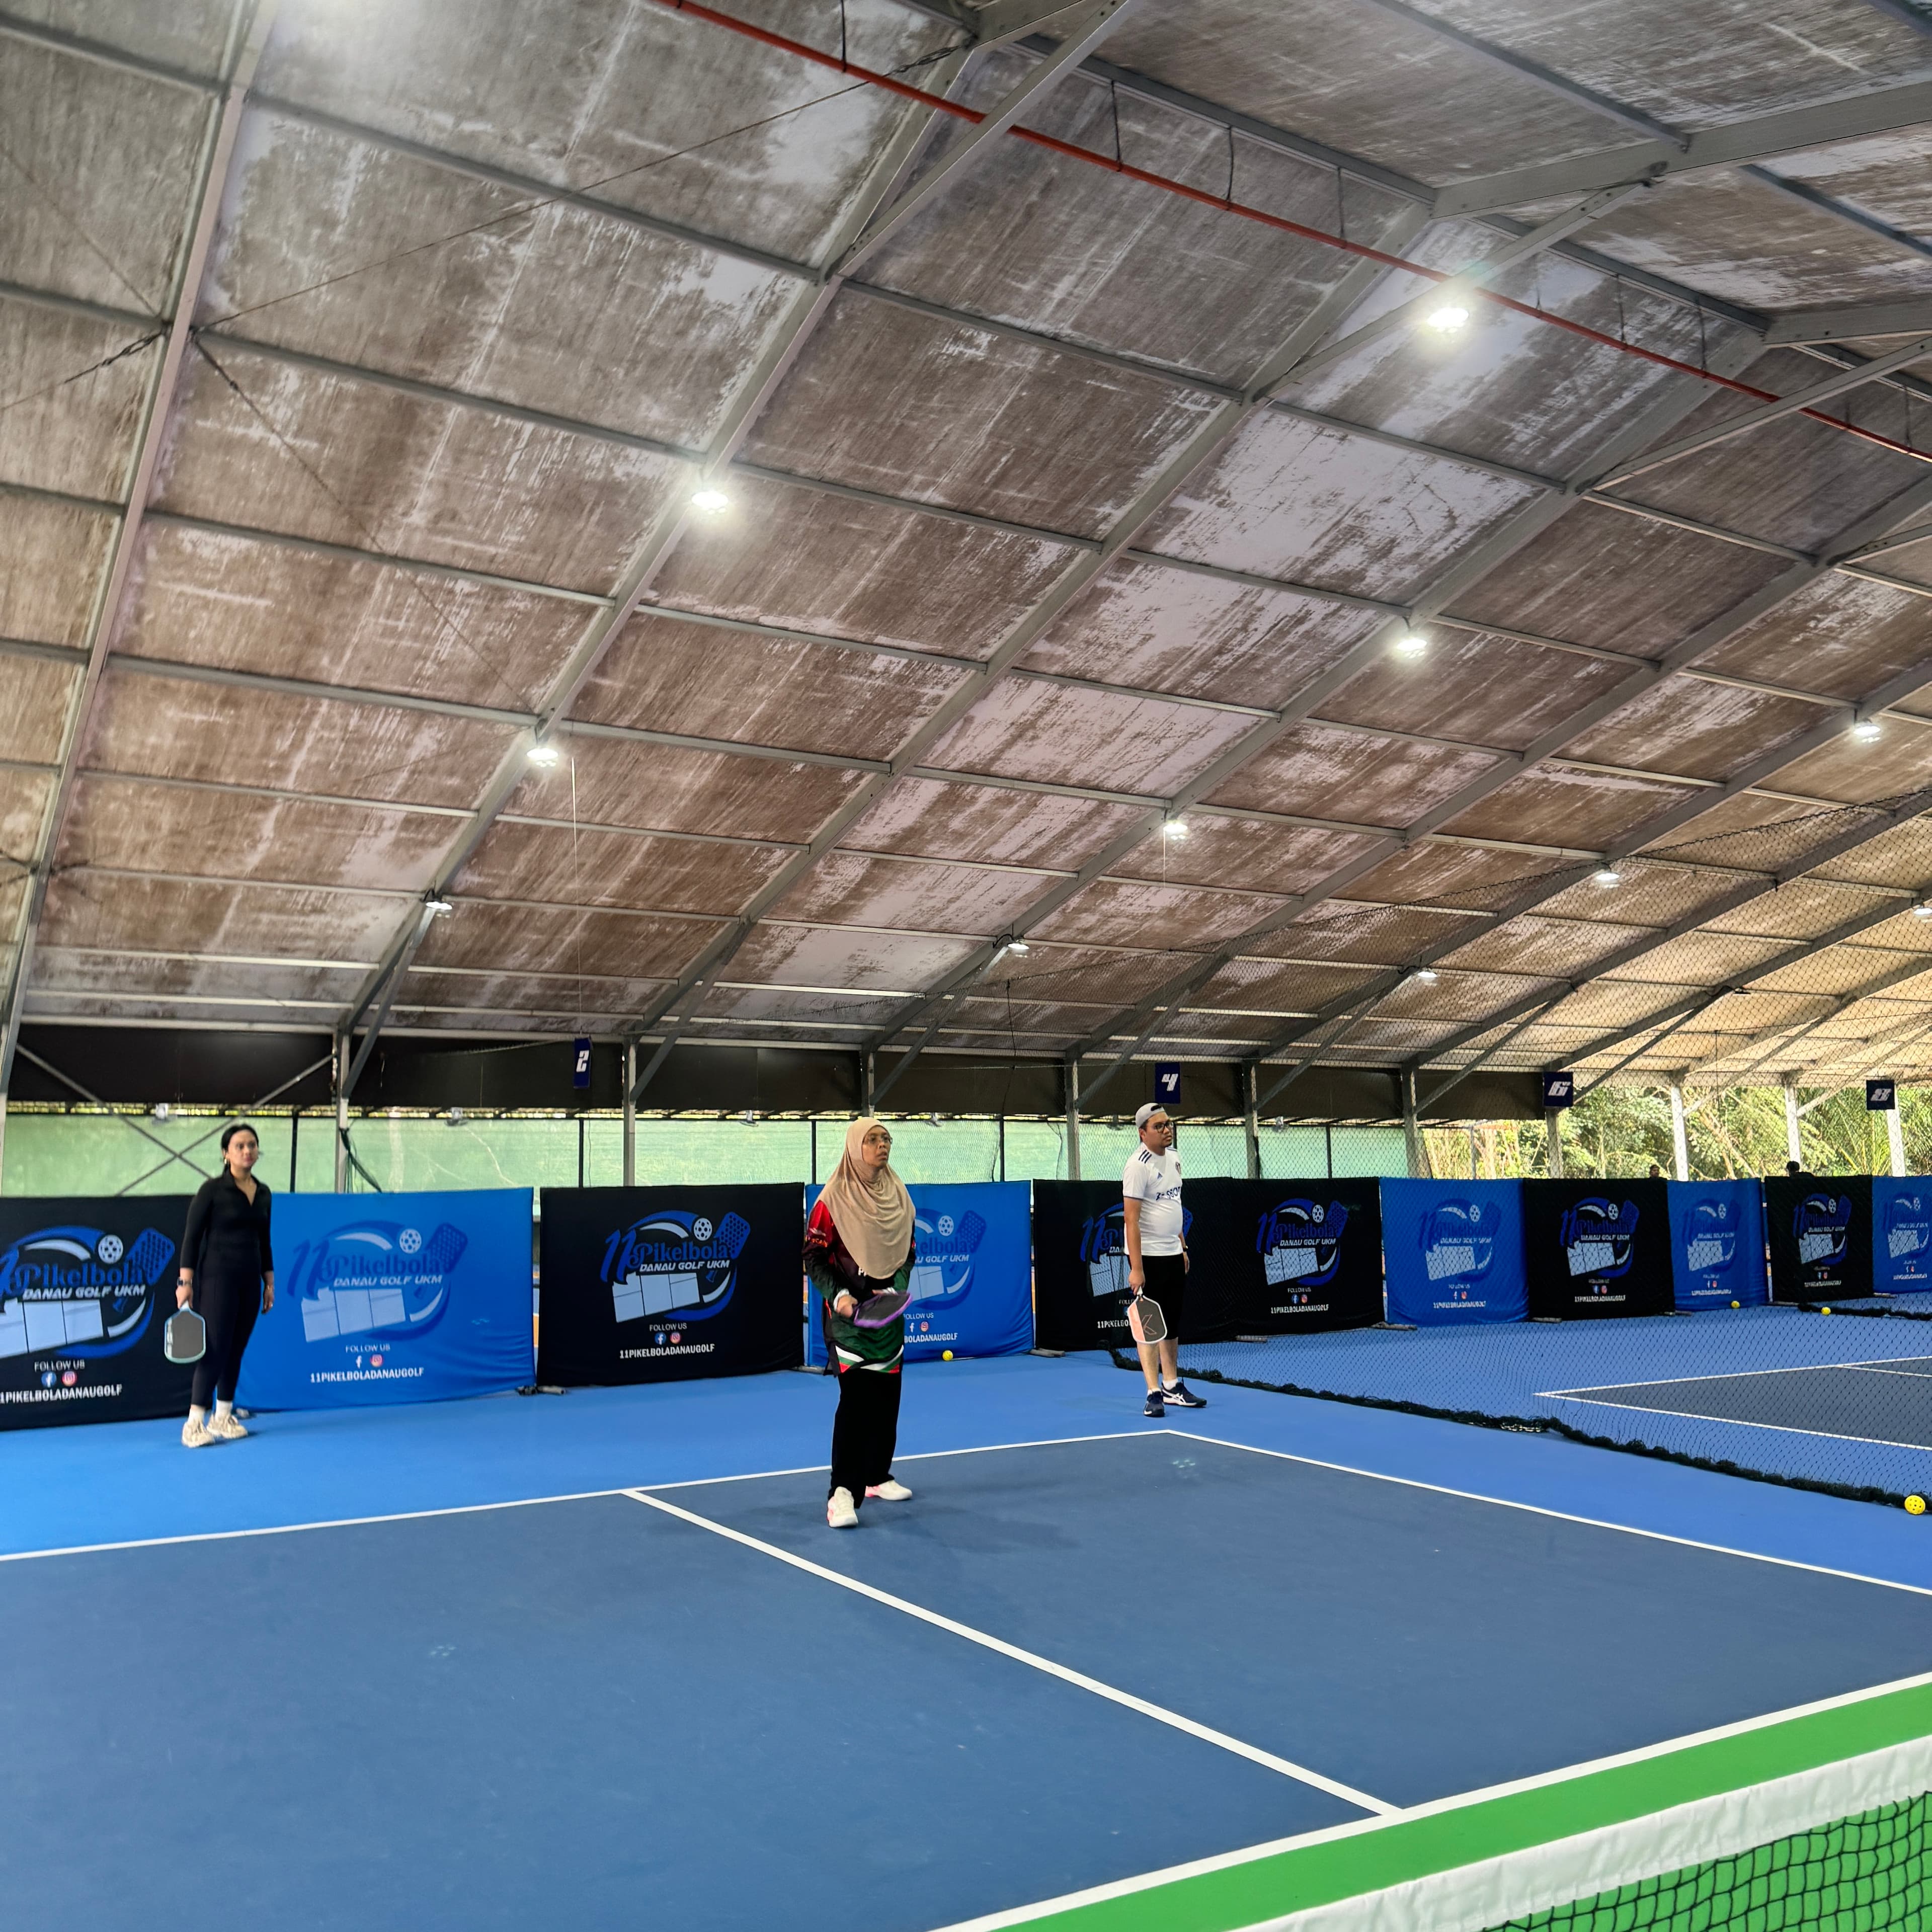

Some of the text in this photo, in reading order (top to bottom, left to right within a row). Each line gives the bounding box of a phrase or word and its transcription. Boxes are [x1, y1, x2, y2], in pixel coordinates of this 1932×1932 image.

[576, 1050, 589, 1072] 2
[1161, 1073, 1178, 1091] 4
[1548, 1081, 1571, 1096] 6
[639, 1259, 730, 1272] DANAU GOLF UKM
[925, 1255, 947, 1263] GOLF
[949, 1254, 970, 1262] UKM
[333, 1273, 442, 1287] DANAU GOLF UKM
[23, 1284, 145, 1300] DANAU GOLF UKM
[649, 1323, 677, 1332] FOLLOW
[346, 1344, 378, 1353] FOLLOW
[619, 1343, 715, 1359] 11PIKELBOLADANAUGOLF
[34, 1360, 71, 1372] FOLLOW
[310, 1366, 424, 1383] 11PIKELBOLADANAUGOLF
